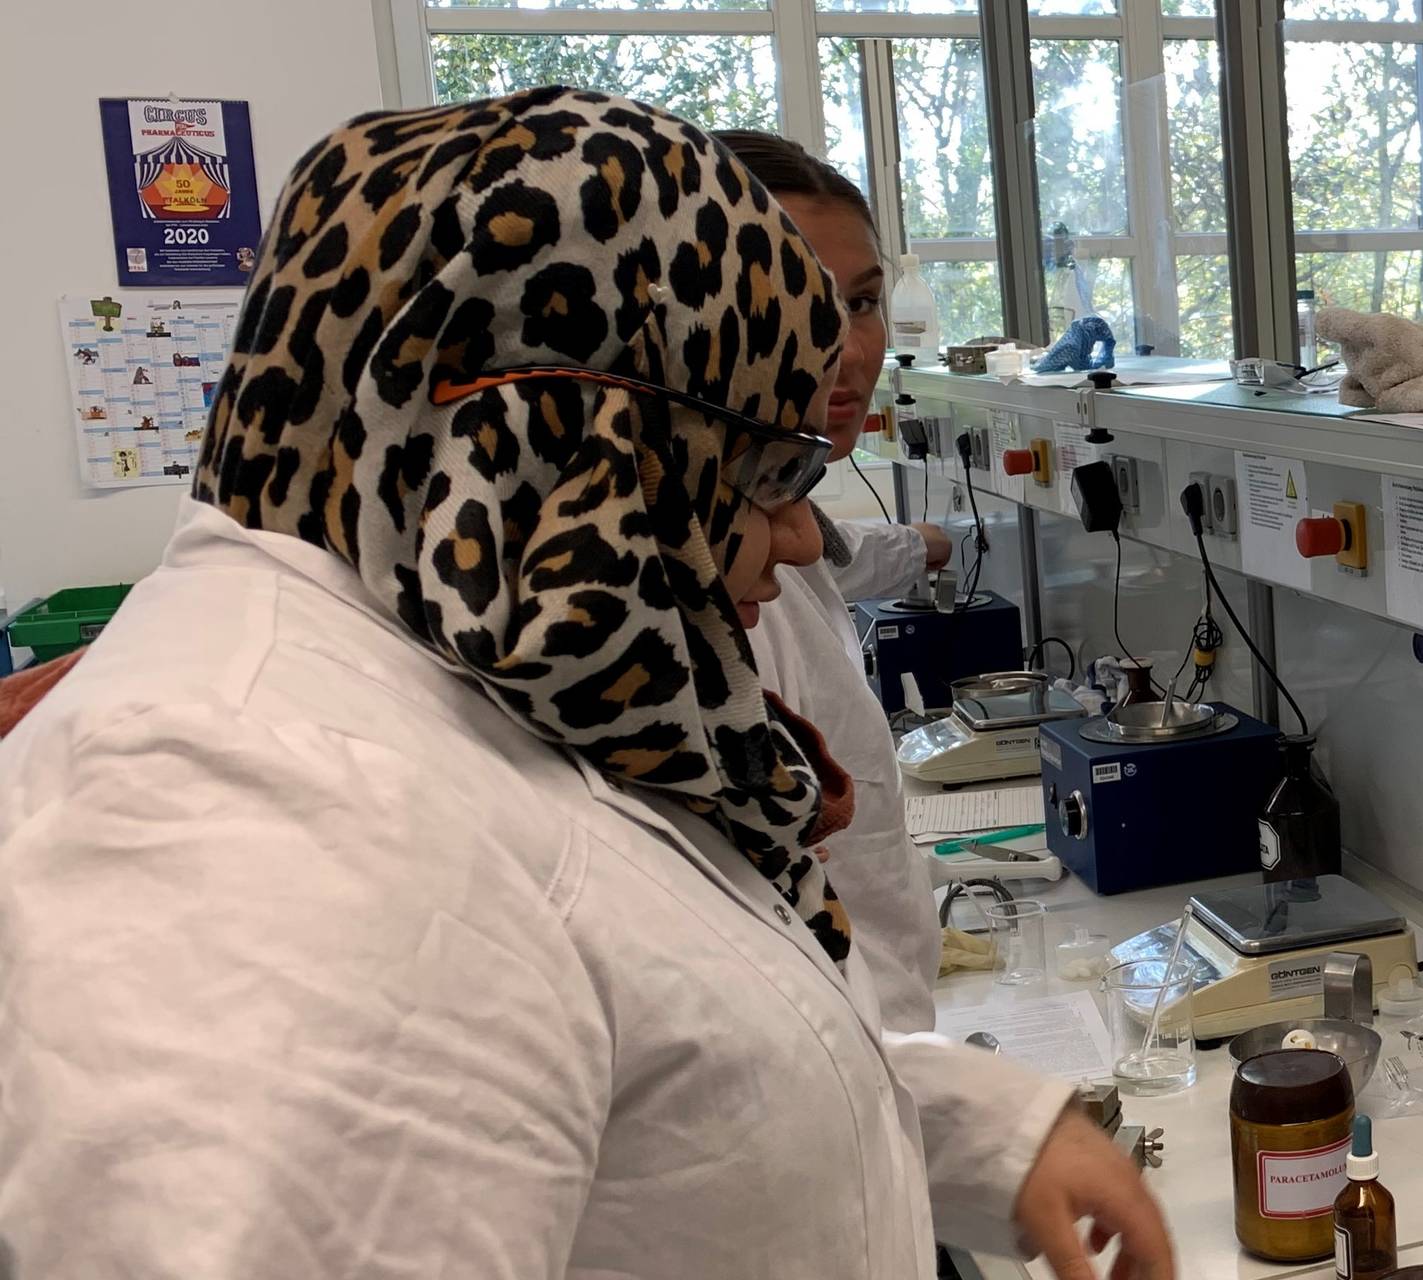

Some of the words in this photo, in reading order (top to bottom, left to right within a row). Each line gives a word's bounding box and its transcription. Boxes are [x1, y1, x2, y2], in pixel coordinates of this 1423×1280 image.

[144, 105, 207, 125] CIRCUS
[141, 129, 215, 137] PHARMACEUTICUS
[176, 180, 191, 189] 50
[164, 228, 209, 244] 2020
[1270, 1162, 1347, 1184] PARACETAMOLU
